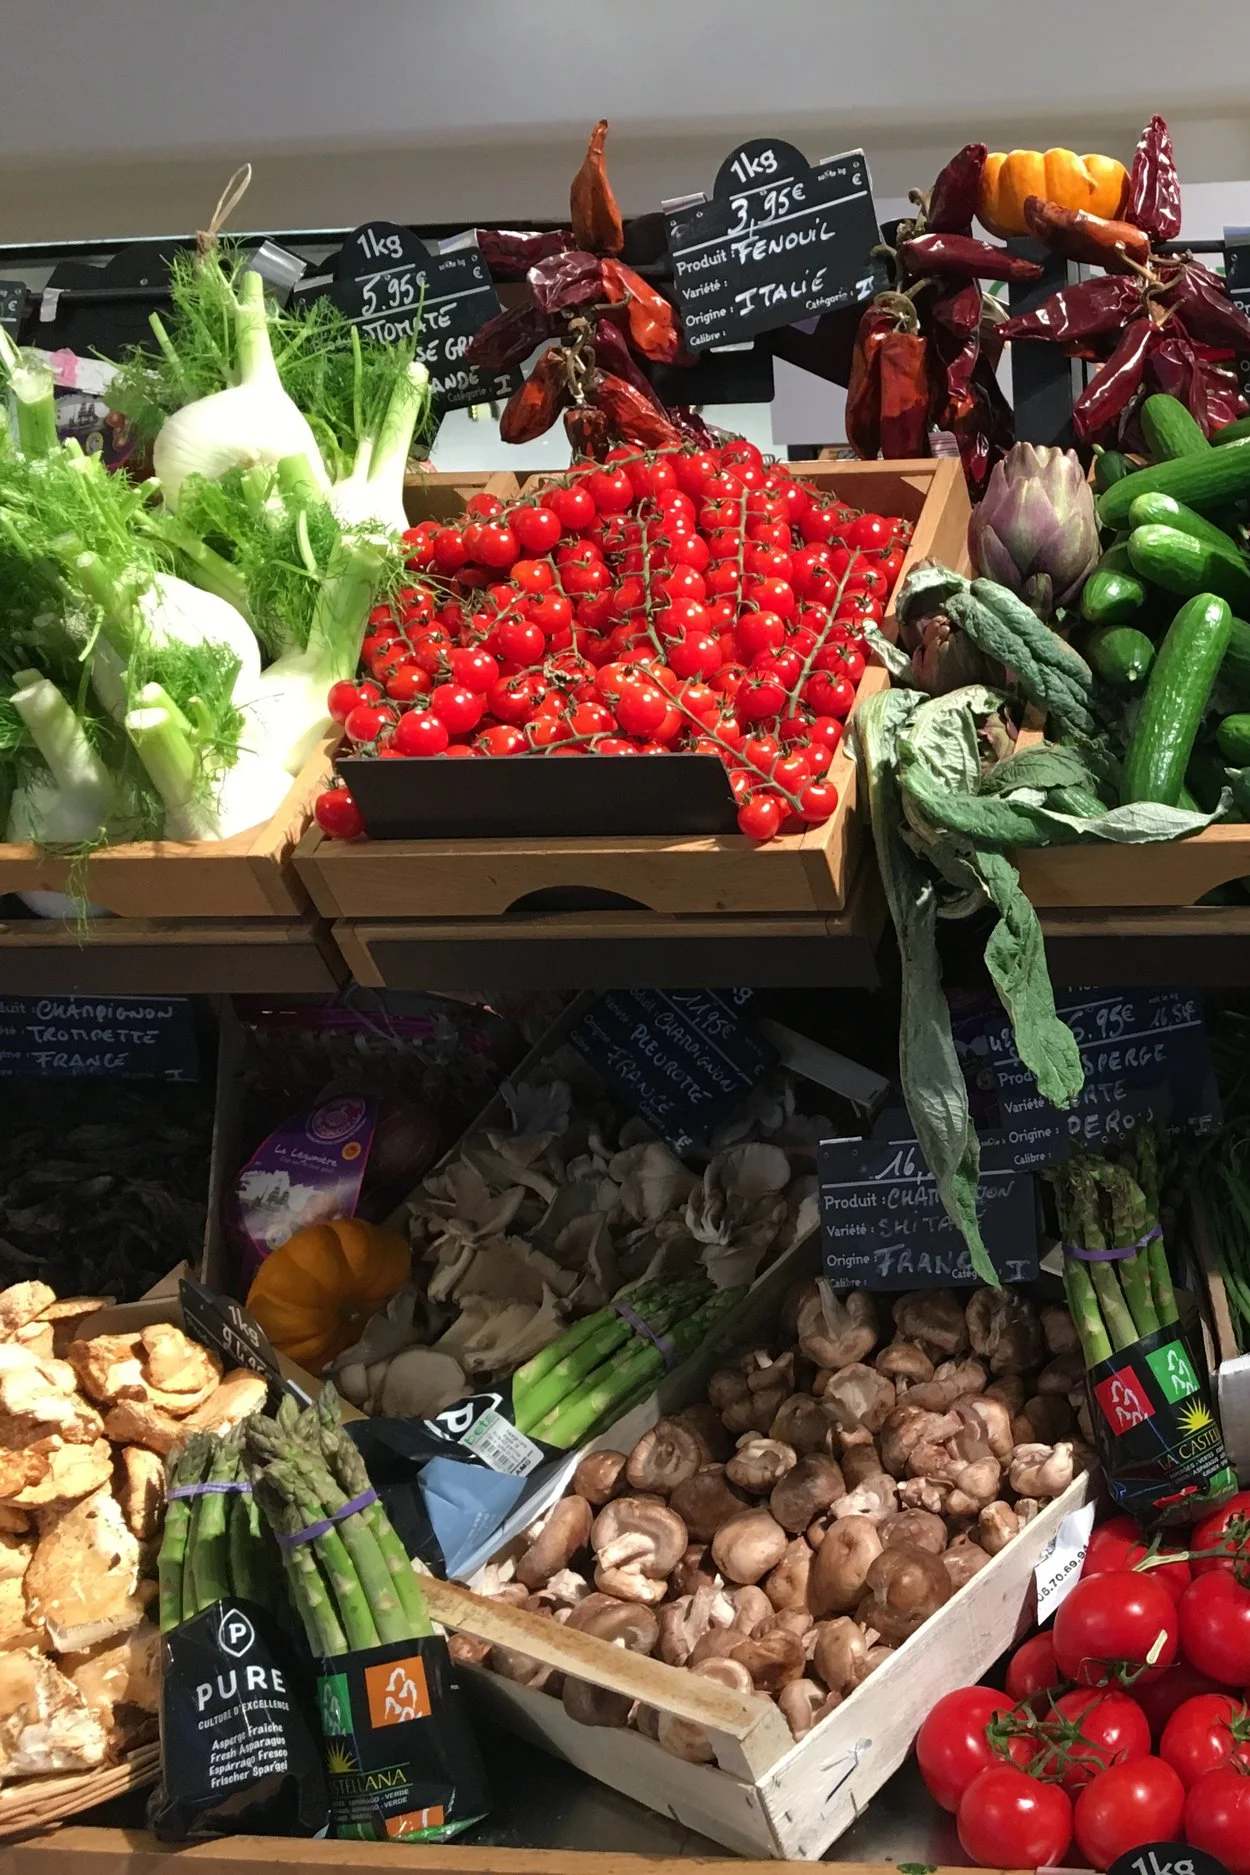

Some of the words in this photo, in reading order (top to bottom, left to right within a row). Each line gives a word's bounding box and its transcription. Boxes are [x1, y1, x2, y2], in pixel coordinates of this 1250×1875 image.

[730, 149, 778, 184] 1kg
[357, 229, 403, 259] 1kg
[676, 250, 727, 276] Produit
[682, 279, 721, 300] Variété
[686, 307, 727, 328] Origine
[690, 330, 721, 347] Calibre
[32, 1051, 129, 1069] FRANCE
[998, 1067, 1039, 1089] Prod
[1082, 1043, 1168, 1077] SPERGE
[1008, 1126, 1052, 1146] Origine
[1014, 1152, 1045, 1166] Calibre
[824, 1194, 877, 1210] Produit
[827, 1222, 868, 1237] Variété
[827, 1254, 870, 1270] Origine
[874, 1243, 973, 1278] FRANC
[228, 1305, 259, 1348] 1kg
[196, 1665, 286, 1712] PURE
[198, 1708, 233, 1731] CULTURE
[210, 1747, 237, 1764] Fresh
